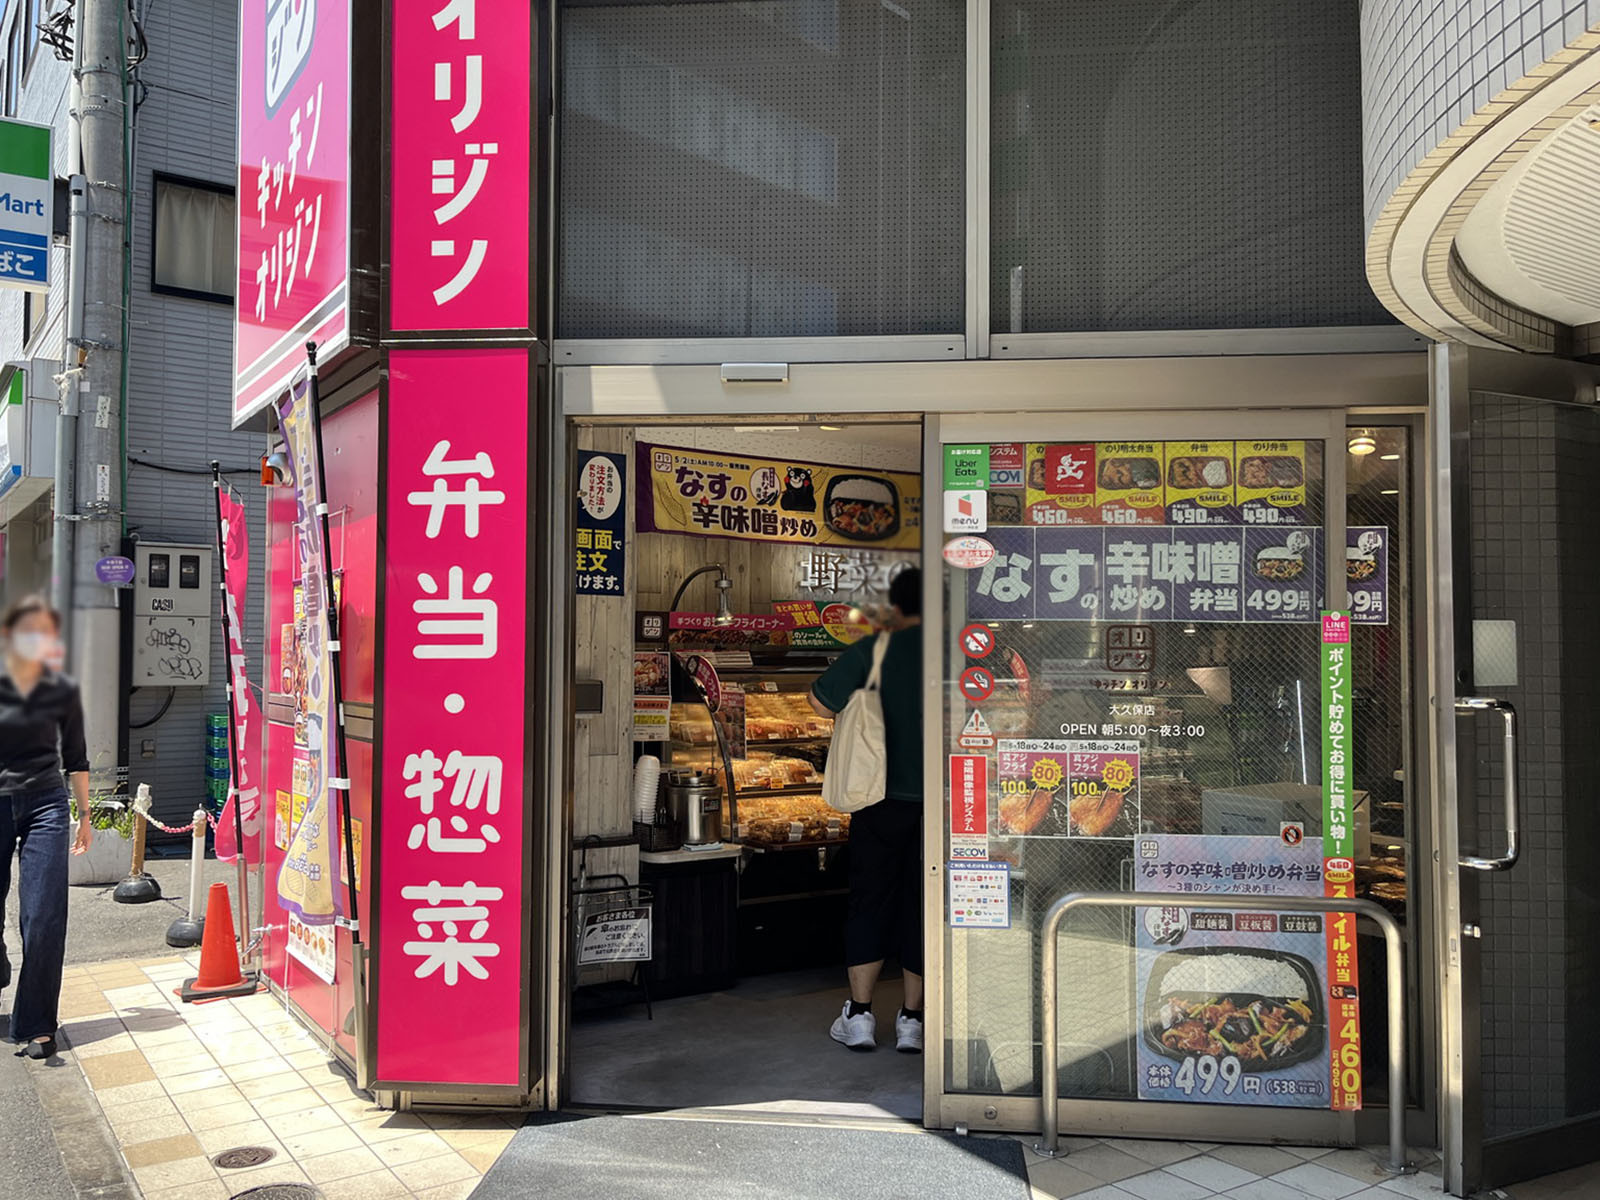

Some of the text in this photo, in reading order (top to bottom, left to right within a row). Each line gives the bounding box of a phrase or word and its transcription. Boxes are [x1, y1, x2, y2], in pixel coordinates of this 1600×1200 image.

[257, 81, 323, 230] キッチン
[256, 193, 323, 323] オリジン
[1104, 443, 1154, 454] のり明太弁当
[1190, 443, 1209, 453] 弁当
[1252, 442, 1289, 452] のり弁当
[955, 459, 977, 467] Uber
[955, 467, 977, 476] Eats
[990, 470, 1020, 483] COM
[674, 465, 749, 503] なすの
[691, 500, 819, 539] 辛味噌炒め
[951, 517, 979, 525] menu
[1106, 540, 1241, 584] 辛味噌
[576, 574, 621, 592] けます。
[1110, 584, 1239, 612] 炒め 弁当
[1325, 620, 1346, 629] LINE
[1094, 679, 1127, 690] キッチン
[401, 439, 506, 986] 弁当・惣菜
[1108, 704, 1157, 717] 大久保店
[1060, 723, 1097, 736] OPEN
[1003, 762, 1027, 772] フライ
[1034, 766, 1055, 781] 80
[1073, 763, 1099, 772] フライ
[1104, 767, 1126, 782] 80
[952, 847, 986, 857] SECOM
[1141, 860, 1322, 882] なすの辛味噌炒め弁当
[1329, 861, 1350, 870] 460
[1332, 884, 1352, 983] スイル弁当
